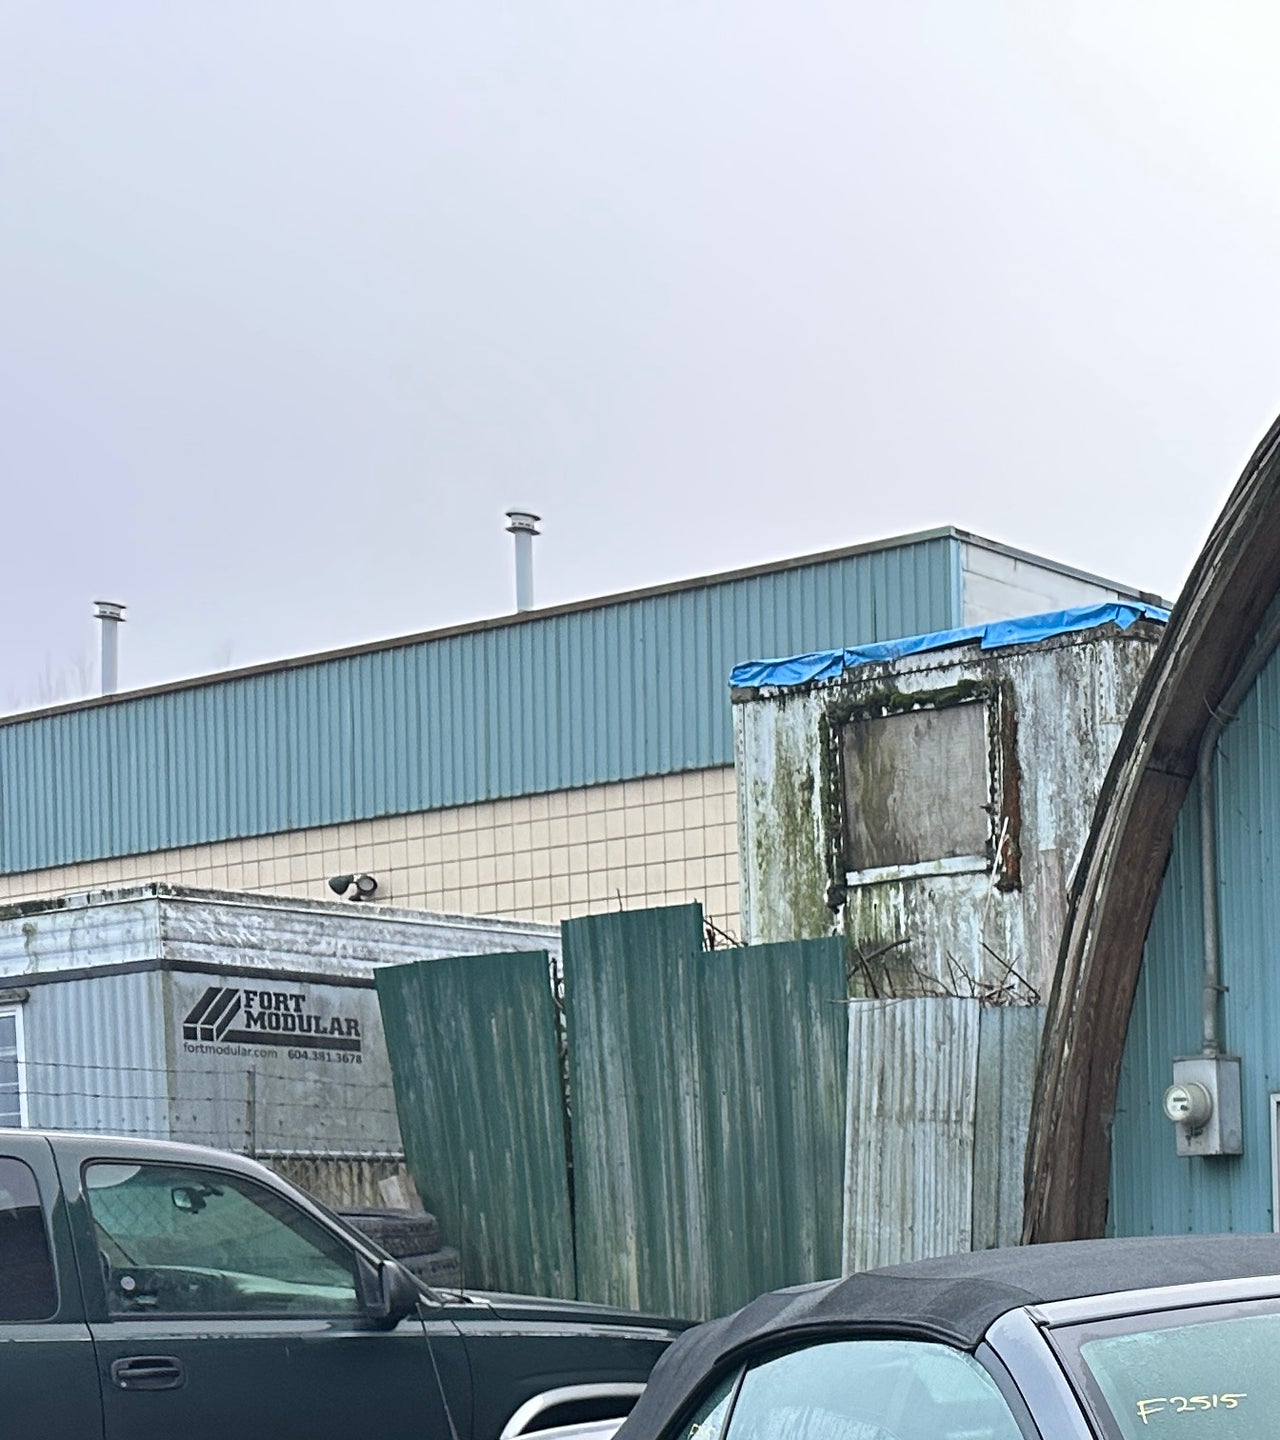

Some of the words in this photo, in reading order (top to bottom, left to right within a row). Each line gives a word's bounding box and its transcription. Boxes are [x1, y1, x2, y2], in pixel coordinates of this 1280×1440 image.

[243, 989, 306, 1013] FORT
[244, 1010, 361, 1037] MODULAR
[183, 1042, 278, 1060] fortmodular.com
[287, 1049, 363, 1065] 604.381.3678
[1136, 1392, 1249, 1426] F2515
